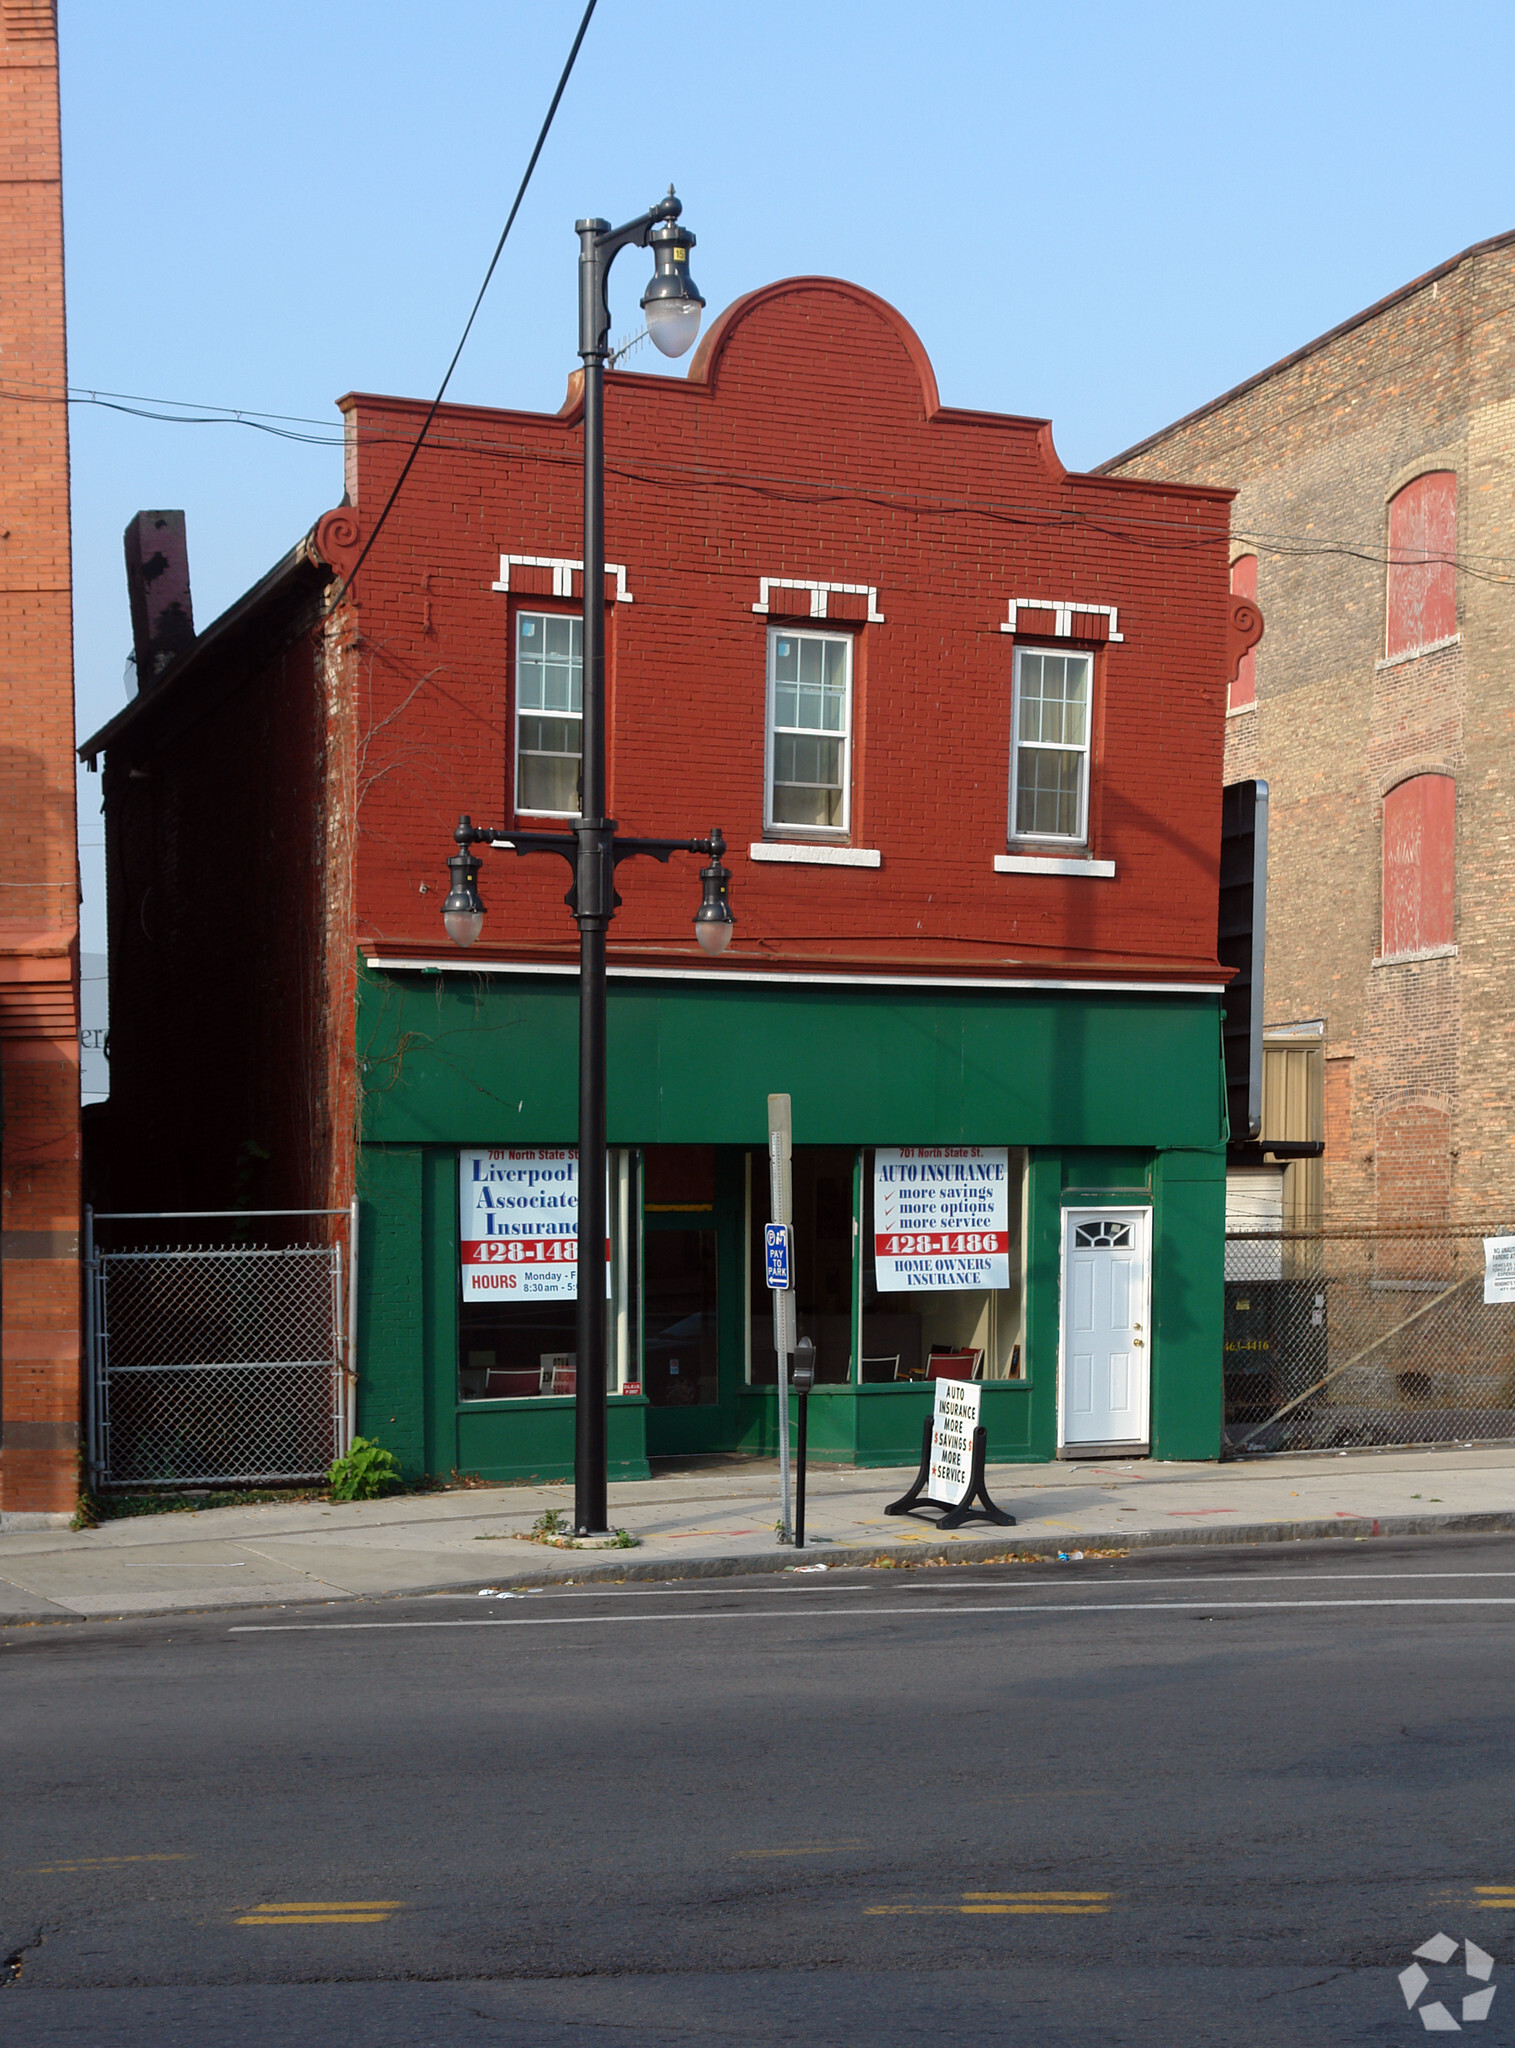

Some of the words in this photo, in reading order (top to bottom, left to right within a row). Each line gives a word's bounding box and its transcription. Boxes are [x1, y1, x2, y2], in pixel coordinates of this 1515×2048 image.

[488, 1150, 505, 1160] 701
[509, 1150, 535, 1160] North
[538, 1149, 565, 1160] State
[899, 1147, 915, 1158] 701
[918, 1147, 942, 1158] North
[944, 1147, 968, 1158] State
[472, 1159, 574, 1187] Liverpool
[879, 1164, 917, 1182] AUTO
[921, 1163, 1004, 1182] INSURANCE
[898, 1187, 936, 1199] more
[939, 1184, 993, 1202] savings
[899, 1203, 936, 1214] more
[940, 1199, 995, 1217] options
[899, 1218, 937, 1229] more
[940, 1213, 991, 1228] service
[885, 1233, 999, 1254] 428-1486
[770, 1249, 783, 1259] PAY
[772, 1259, 782, 1268] TO
[894, 1259, 932, 1272] HOME
[935, 1258, 992, 1271] OWNERS
[525, 1271, 562, 1282] Monday
[768, 1267, 787, 1277] PARK
[907, 1272, 981, 1286] INSURANCE
[472, 1274, 517, 1289] HOURS
[946, 1385, 965, 1401] AUTO
[939, 1400, 976, 1420] INSURANCE
[943, 1418, 963, 1434] MORE
[939, 1433, 967, 1451] SAVINGS
[941, 1450, 961, 1466] MORE
[937, 1465, 965, 1484] SERVICE
